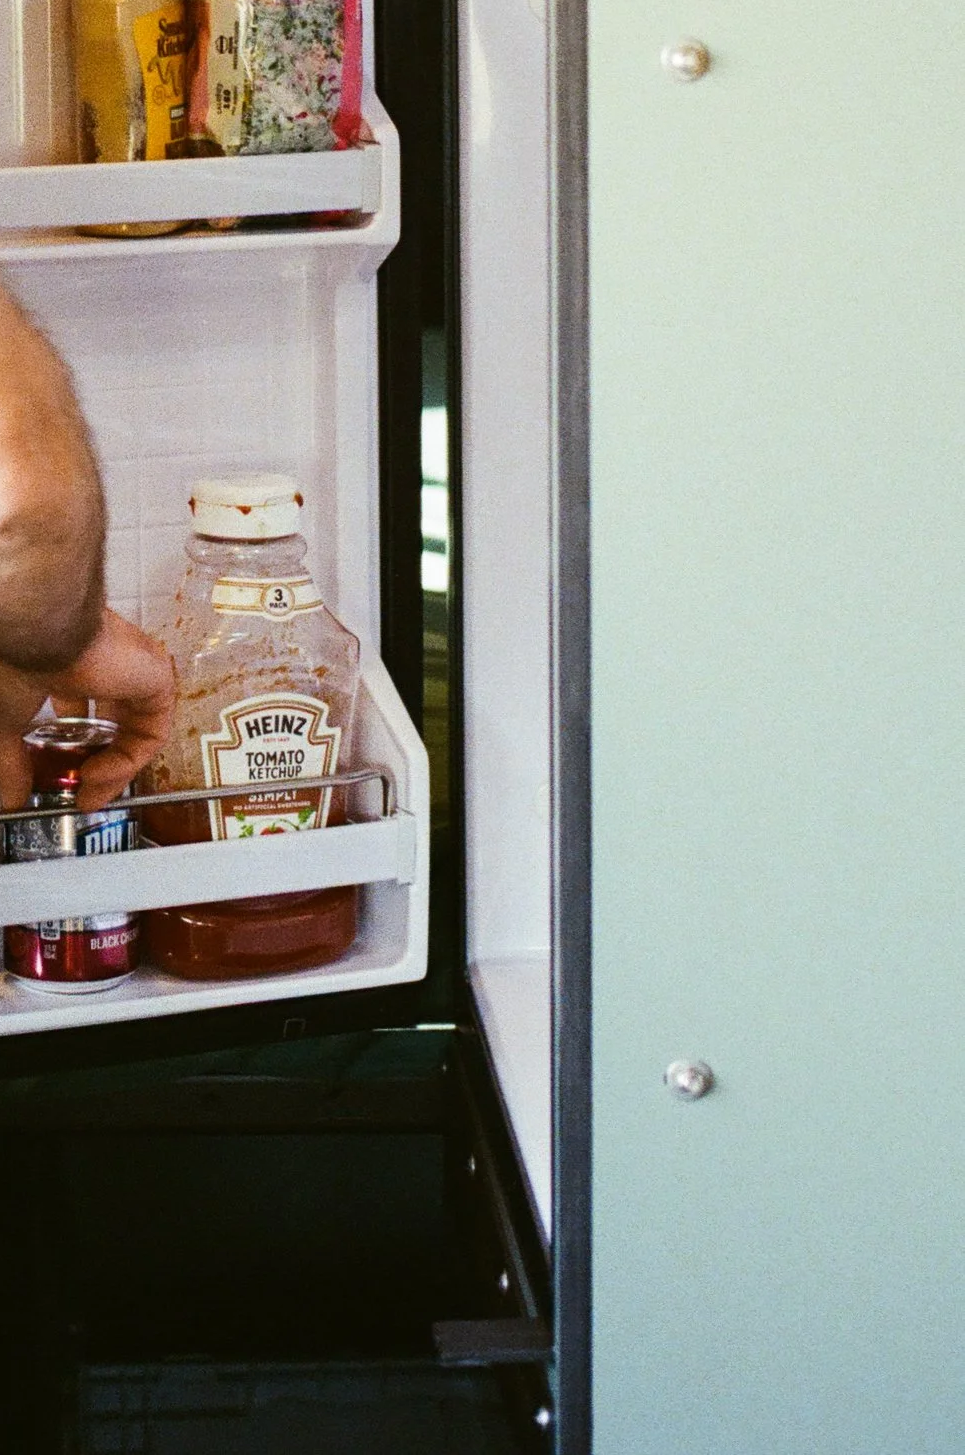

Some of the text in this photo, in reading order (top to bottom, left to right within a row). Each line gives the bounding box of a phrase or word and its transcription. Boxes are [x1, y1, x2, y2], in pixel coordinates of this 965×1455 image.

[274, 588, 284, 602] 3
[245, 714, 307, 739] HEINZ
[245, 749, 305, 767] TOMATO
[248, 765, 302, 780] KETCHUP
[90, 934, 119, 951] BLACK
